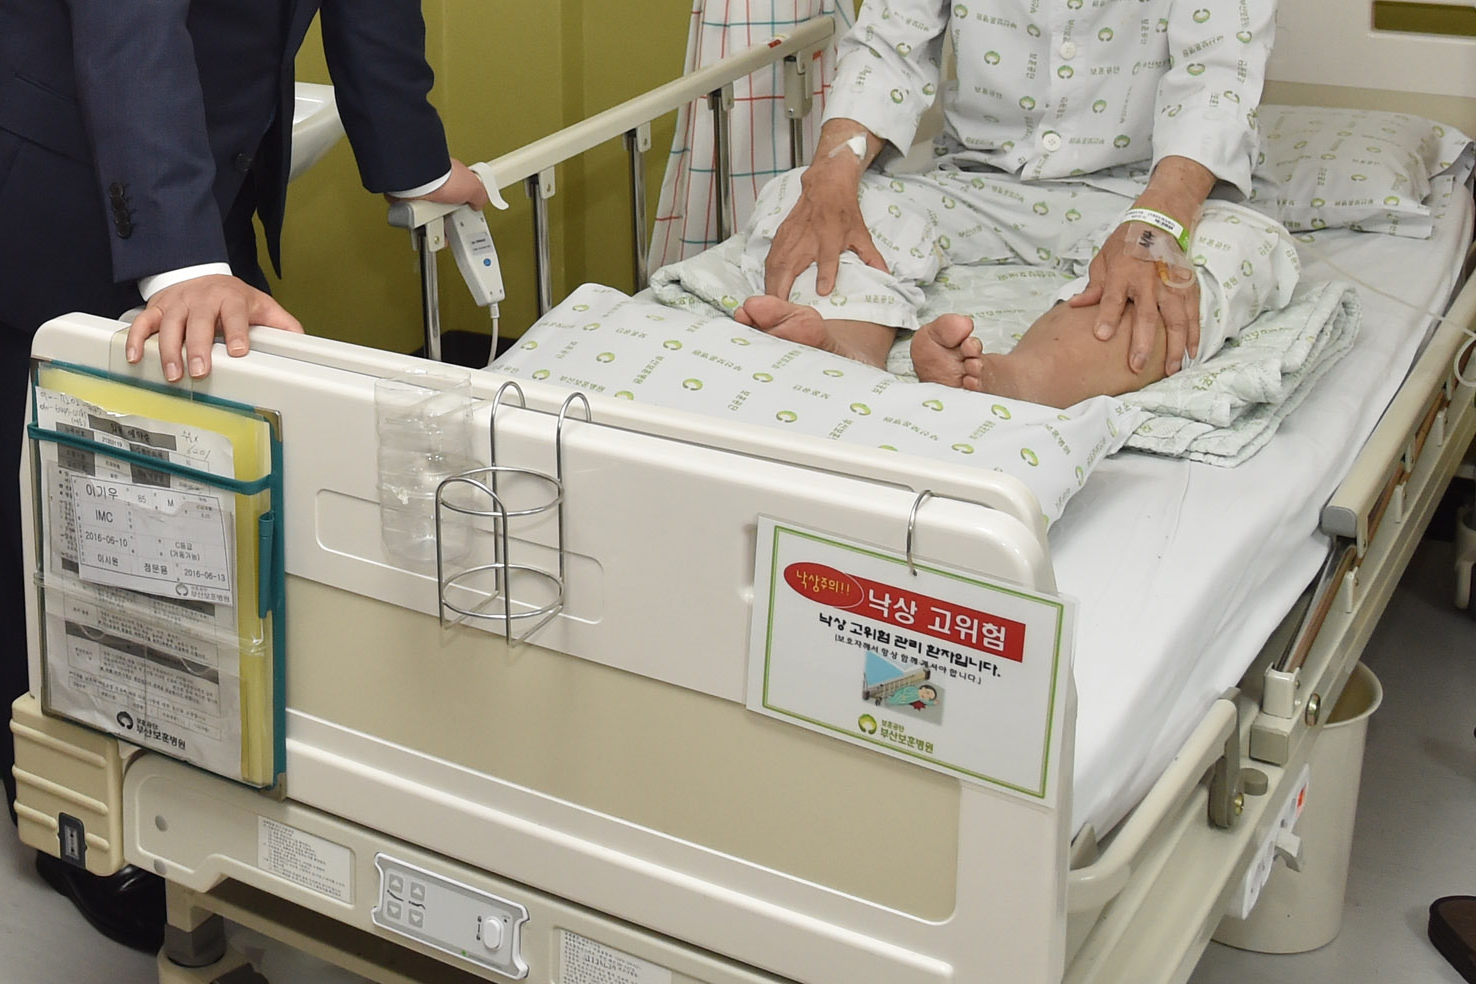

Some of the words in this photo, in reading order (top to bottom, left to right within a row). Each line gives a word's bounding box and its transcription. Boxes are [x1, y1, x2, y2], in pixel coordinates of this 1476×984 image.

[86, 483, 118, 500] 이기우
[167, 498, 174, 508] M
[95, 509, 114, 524] IMC
[85, 531, 128, 548] 2016-06-10
[184, 568, 226, 582] 2016-06-13
[796, 569, 850, 596] 낙상주의!!
[868, 588, 918, 626] 낙상
[927, 604, 1006, 652] 고위험
[819, 612, 847, 632] 낙상
[850, 622, 890, 644] 고위험
[894, 634, 922, 654] 관리
[926, 644, 1001, 678] 환자입니다.
[880, 647, 898, 661] 항상
[900, 653, 918, 666] 함께
[136, 724, 186, 751] 부산보훈병원
[880, 727, 934, 754] 부산보훈병원
